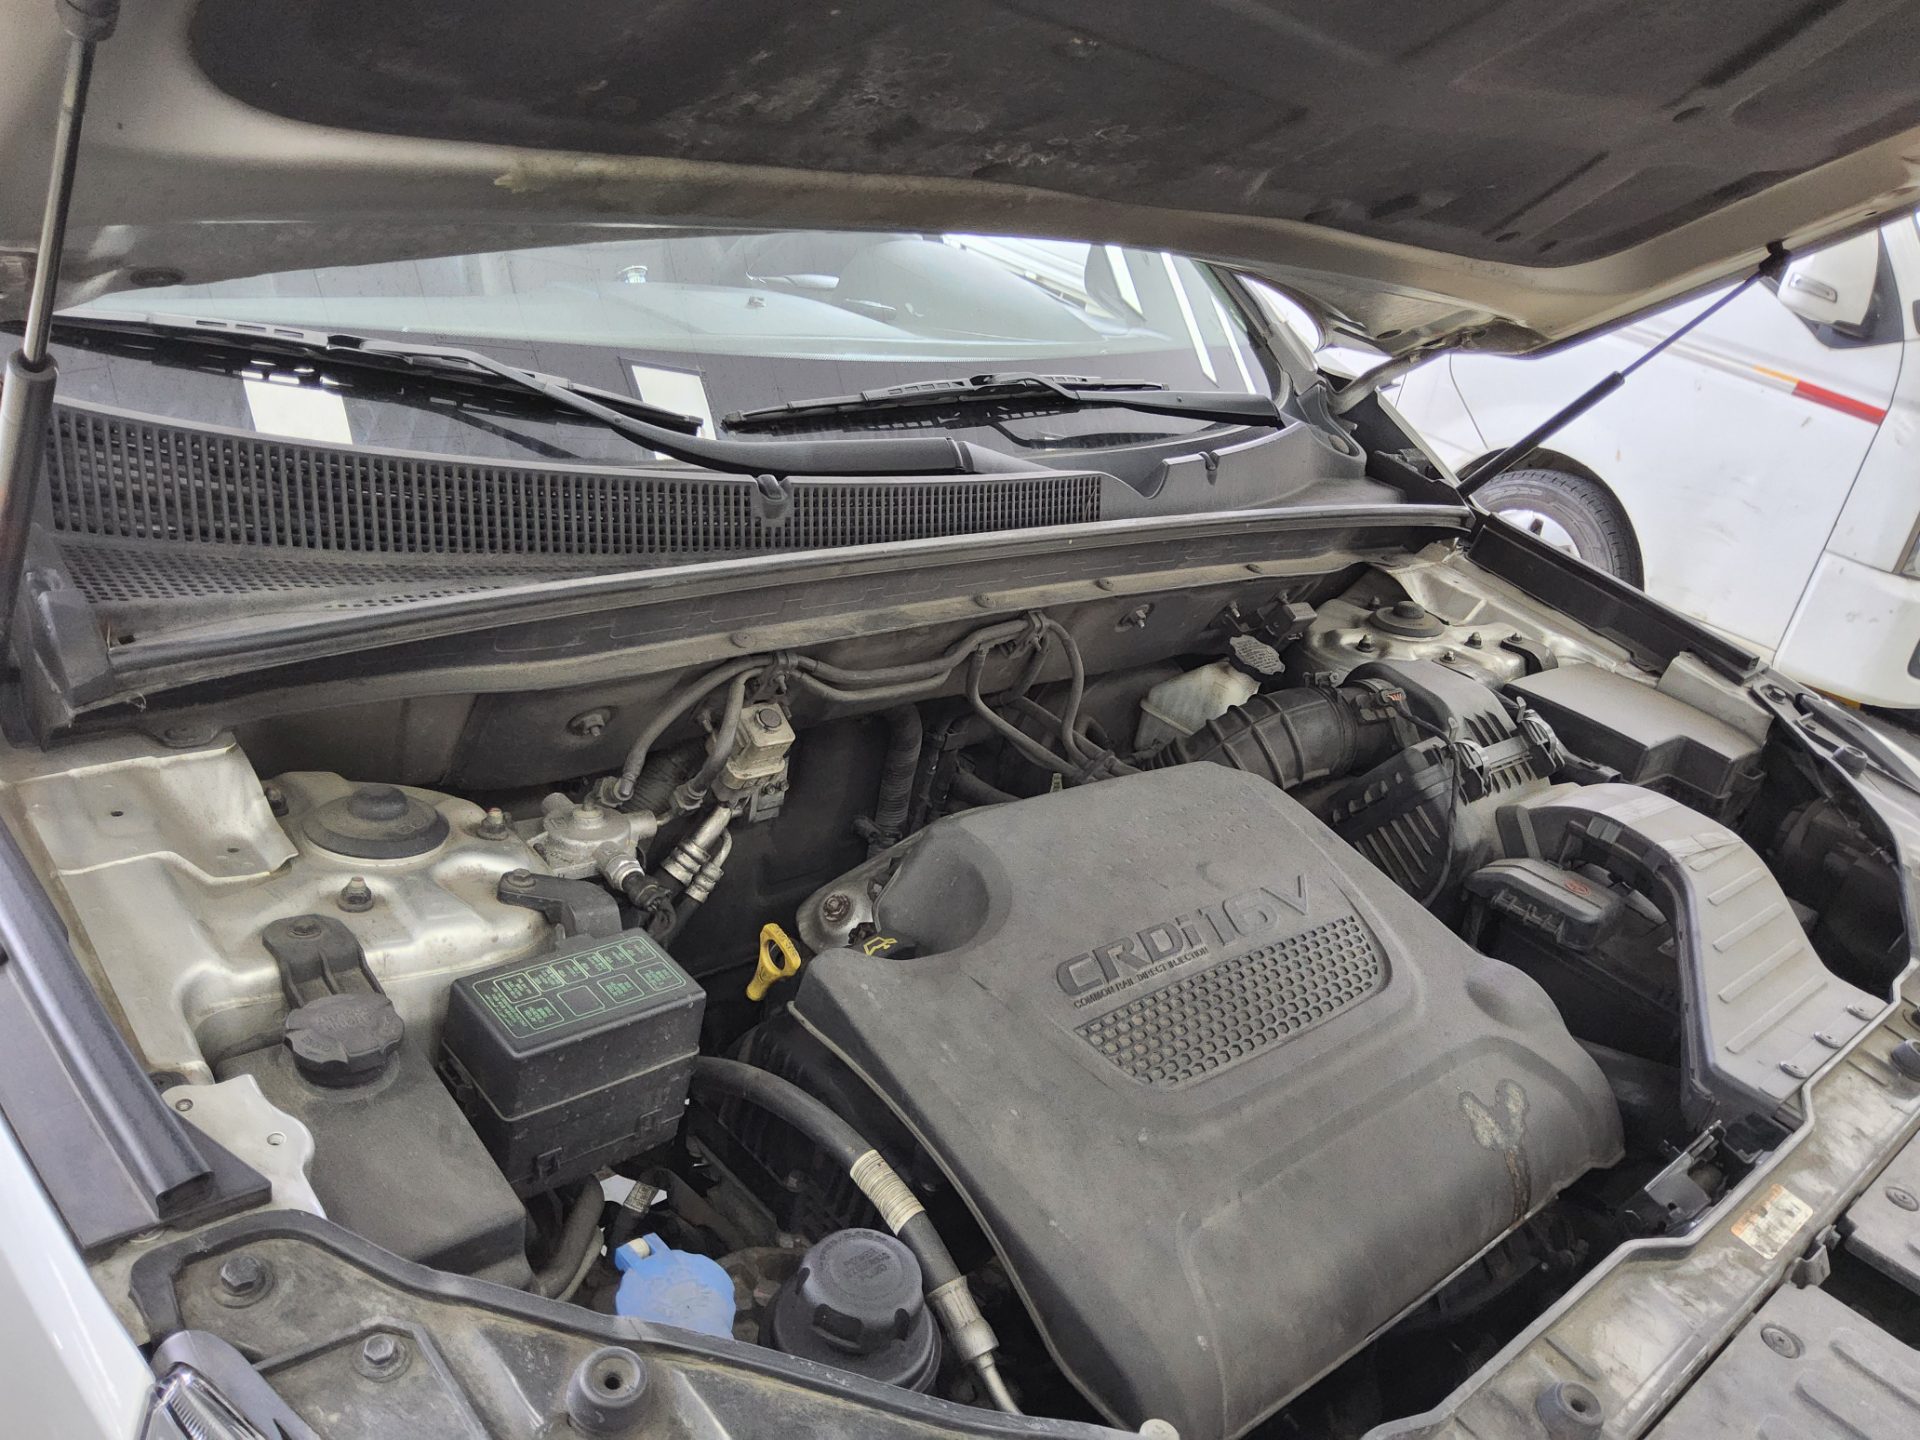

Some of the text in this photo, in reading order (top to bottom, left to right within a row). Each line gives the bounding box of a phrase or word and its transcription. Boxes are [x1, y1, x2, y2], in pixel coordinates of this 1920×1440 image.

[1073, 946, 1210, 1009] COMMON RAIL DIRECT INJECTION
